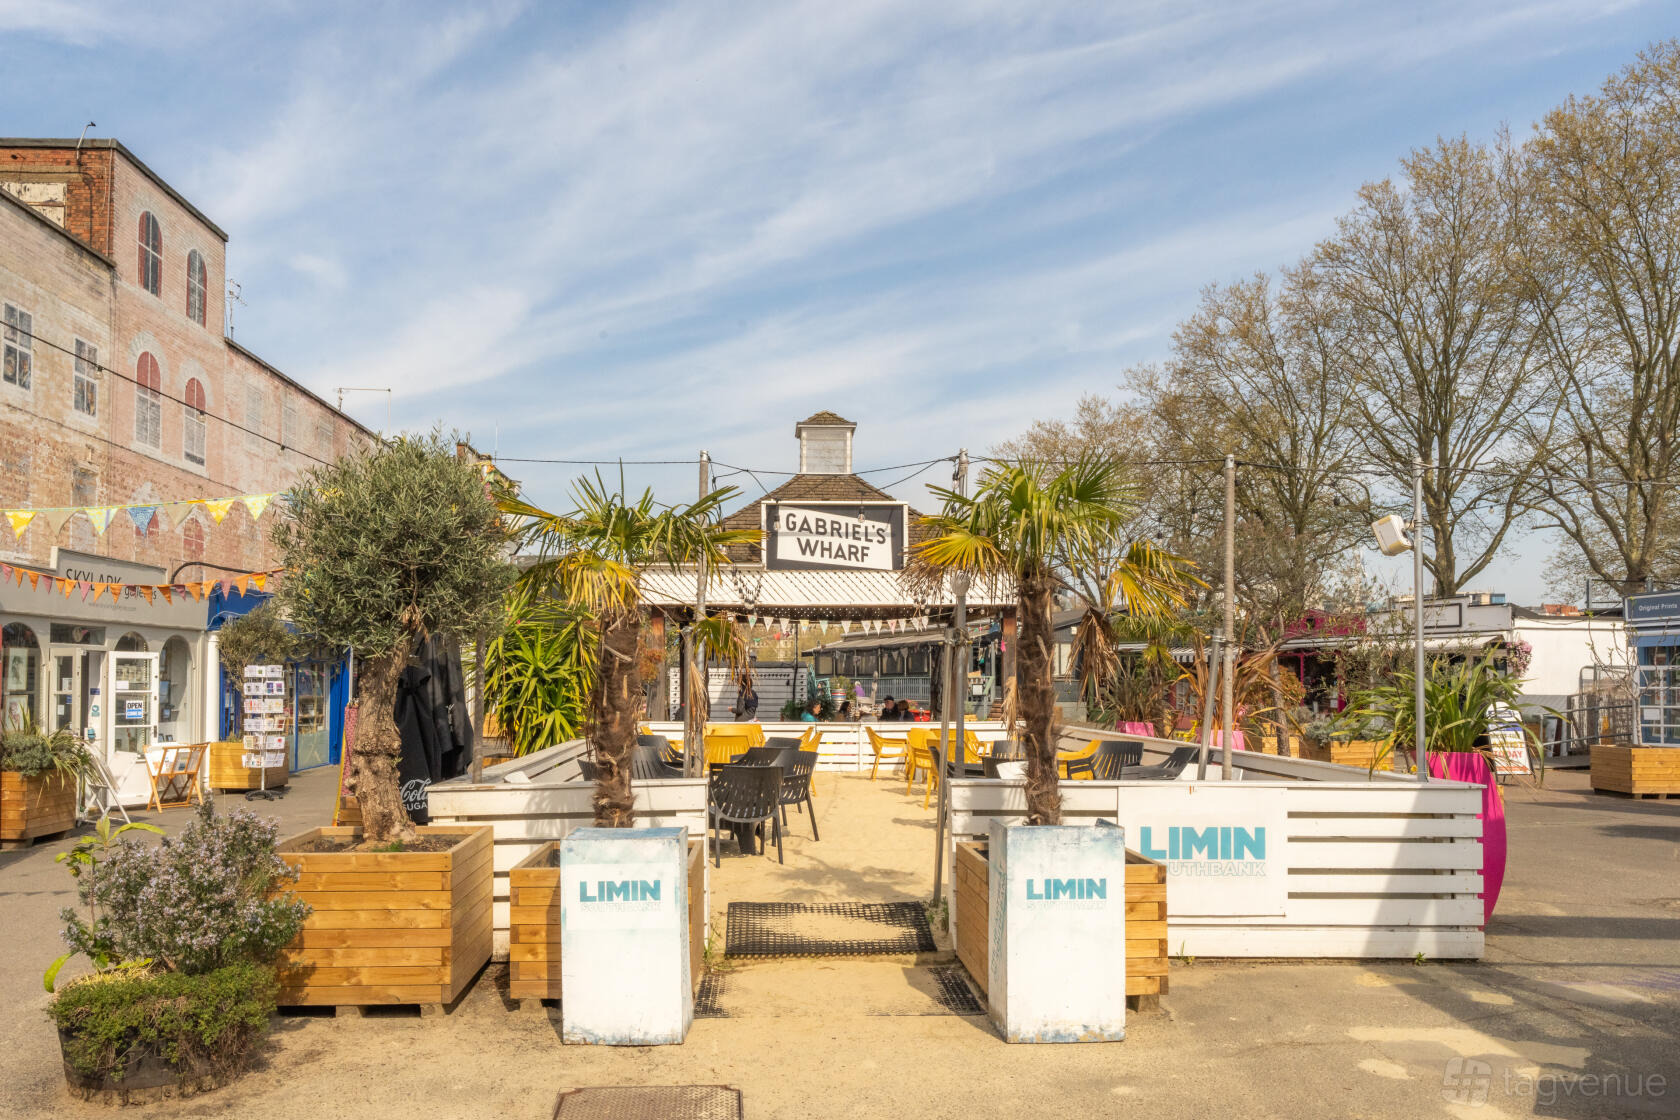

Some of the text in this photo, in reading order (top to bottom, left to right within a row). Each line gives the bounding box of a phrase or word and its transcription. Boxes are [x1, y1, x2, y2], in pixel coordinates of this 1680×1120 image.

[785, 513, 886, 545] GABRIEL'S
[796, 537, 871, 563] WHARF
[1140, 826, 1266, 860] LIMIN
[579, 880, 661, 902] LIMIN
[1026, 878, 1107, 900] LIMIN
